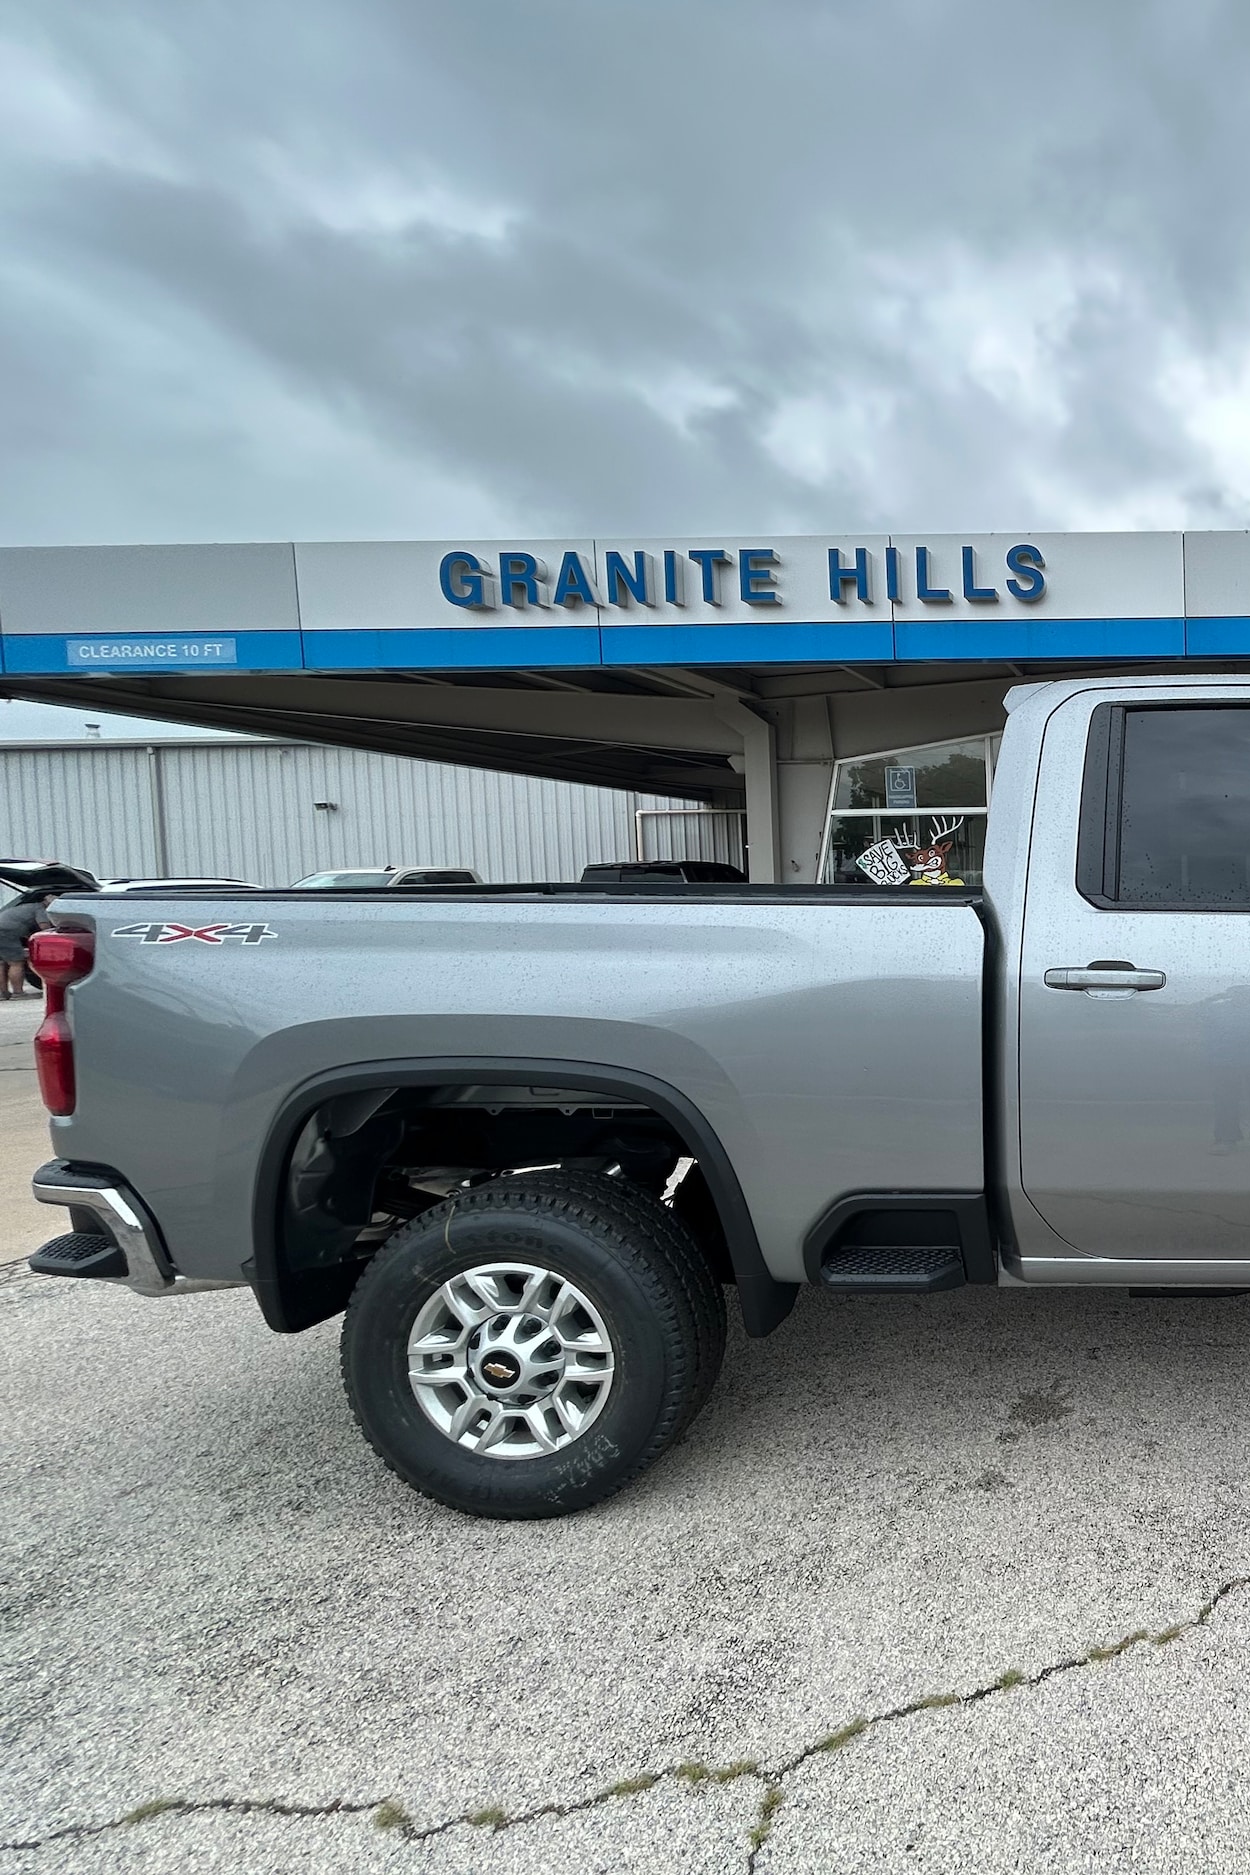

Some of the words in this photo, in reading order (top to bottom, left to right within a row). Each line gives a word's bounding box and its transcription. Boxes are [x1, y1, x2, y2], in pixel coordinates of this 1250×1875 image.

[439, 548, 781, 609] GRANITE
[828, 543, 1046, 604] HILLS
[79, 644, 176, 658] CLEARANCE
[182, 644, 199, 657] 10
[204, 643, 223, 656] FT
[870, 855, 898, 880] BIG
